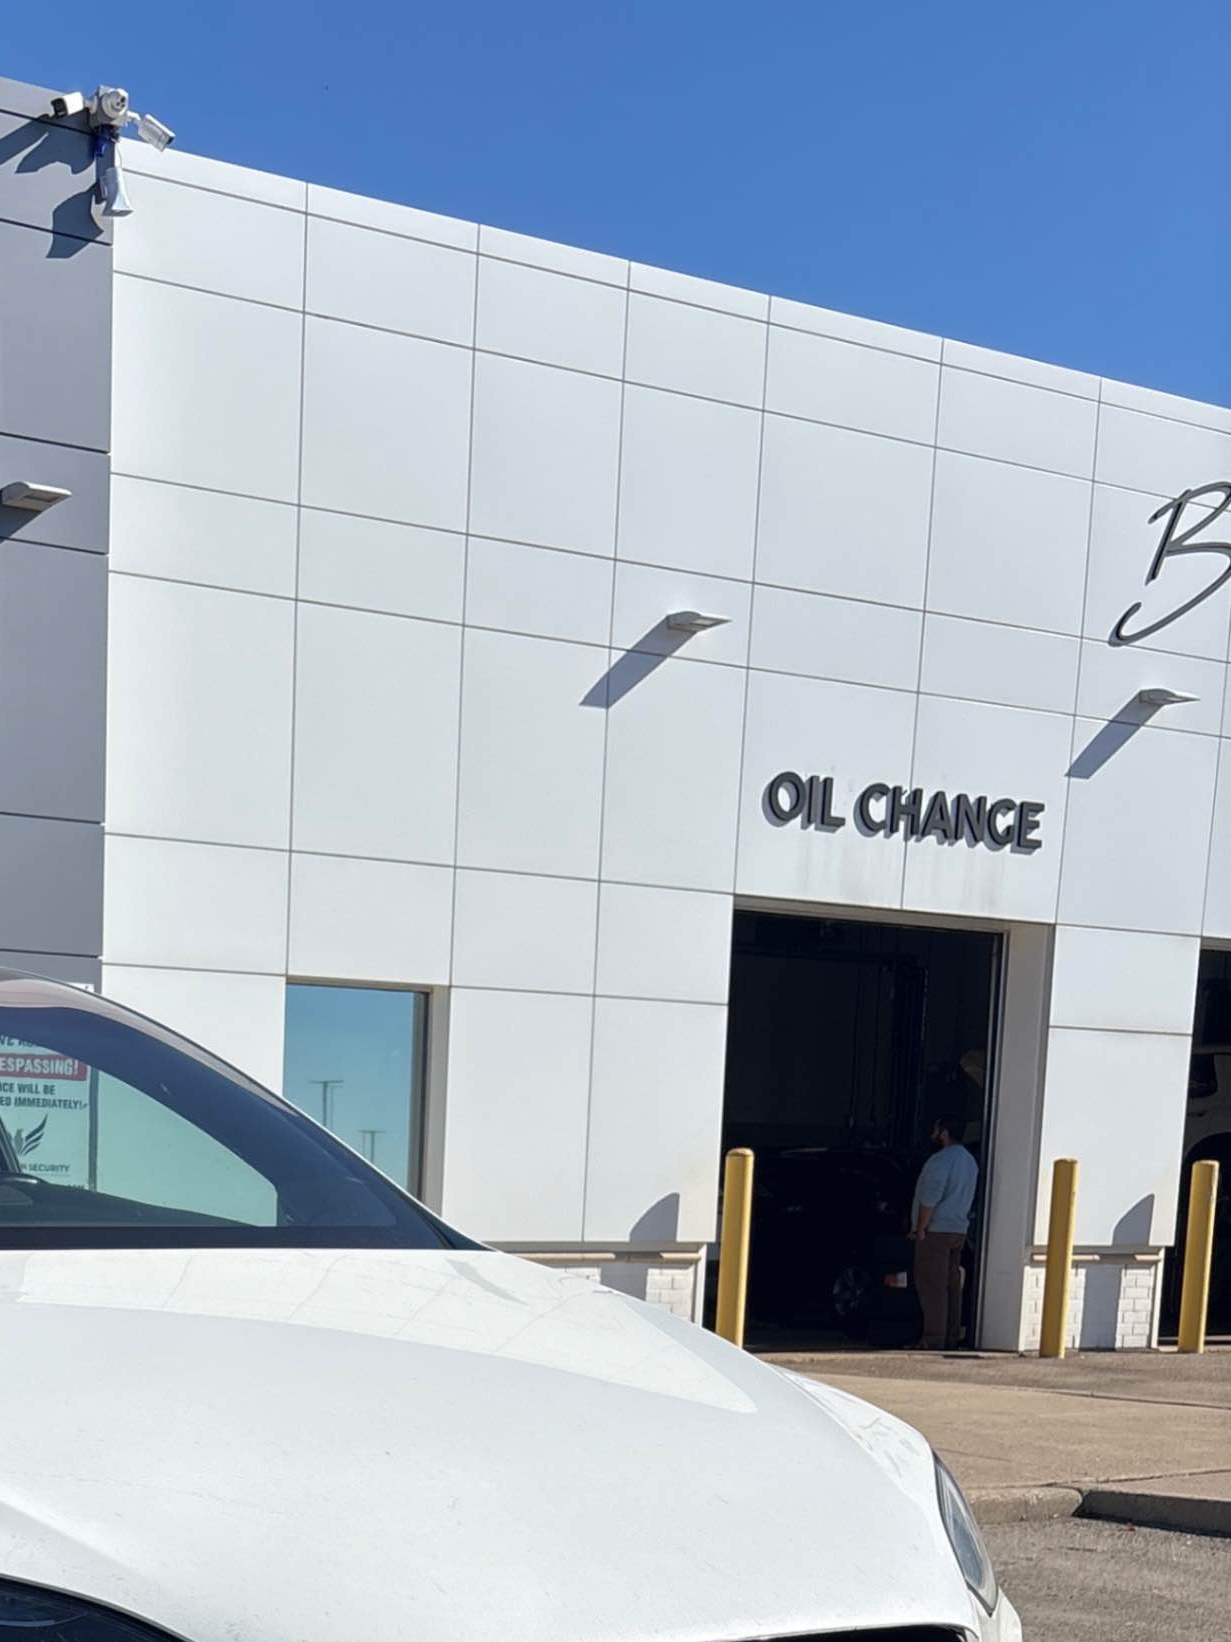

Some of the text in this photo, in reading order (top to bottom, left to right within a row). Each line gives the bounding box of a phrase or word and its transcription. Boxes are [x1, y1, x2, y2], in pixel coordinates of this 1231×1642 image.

[761, 771, 1045, 854] OIL CHANGE
[17, 1083, 41, 1094] WILL
[43, 1084, 56, 1095] BE
[29, 1163, 71, 1172] SECURITY
